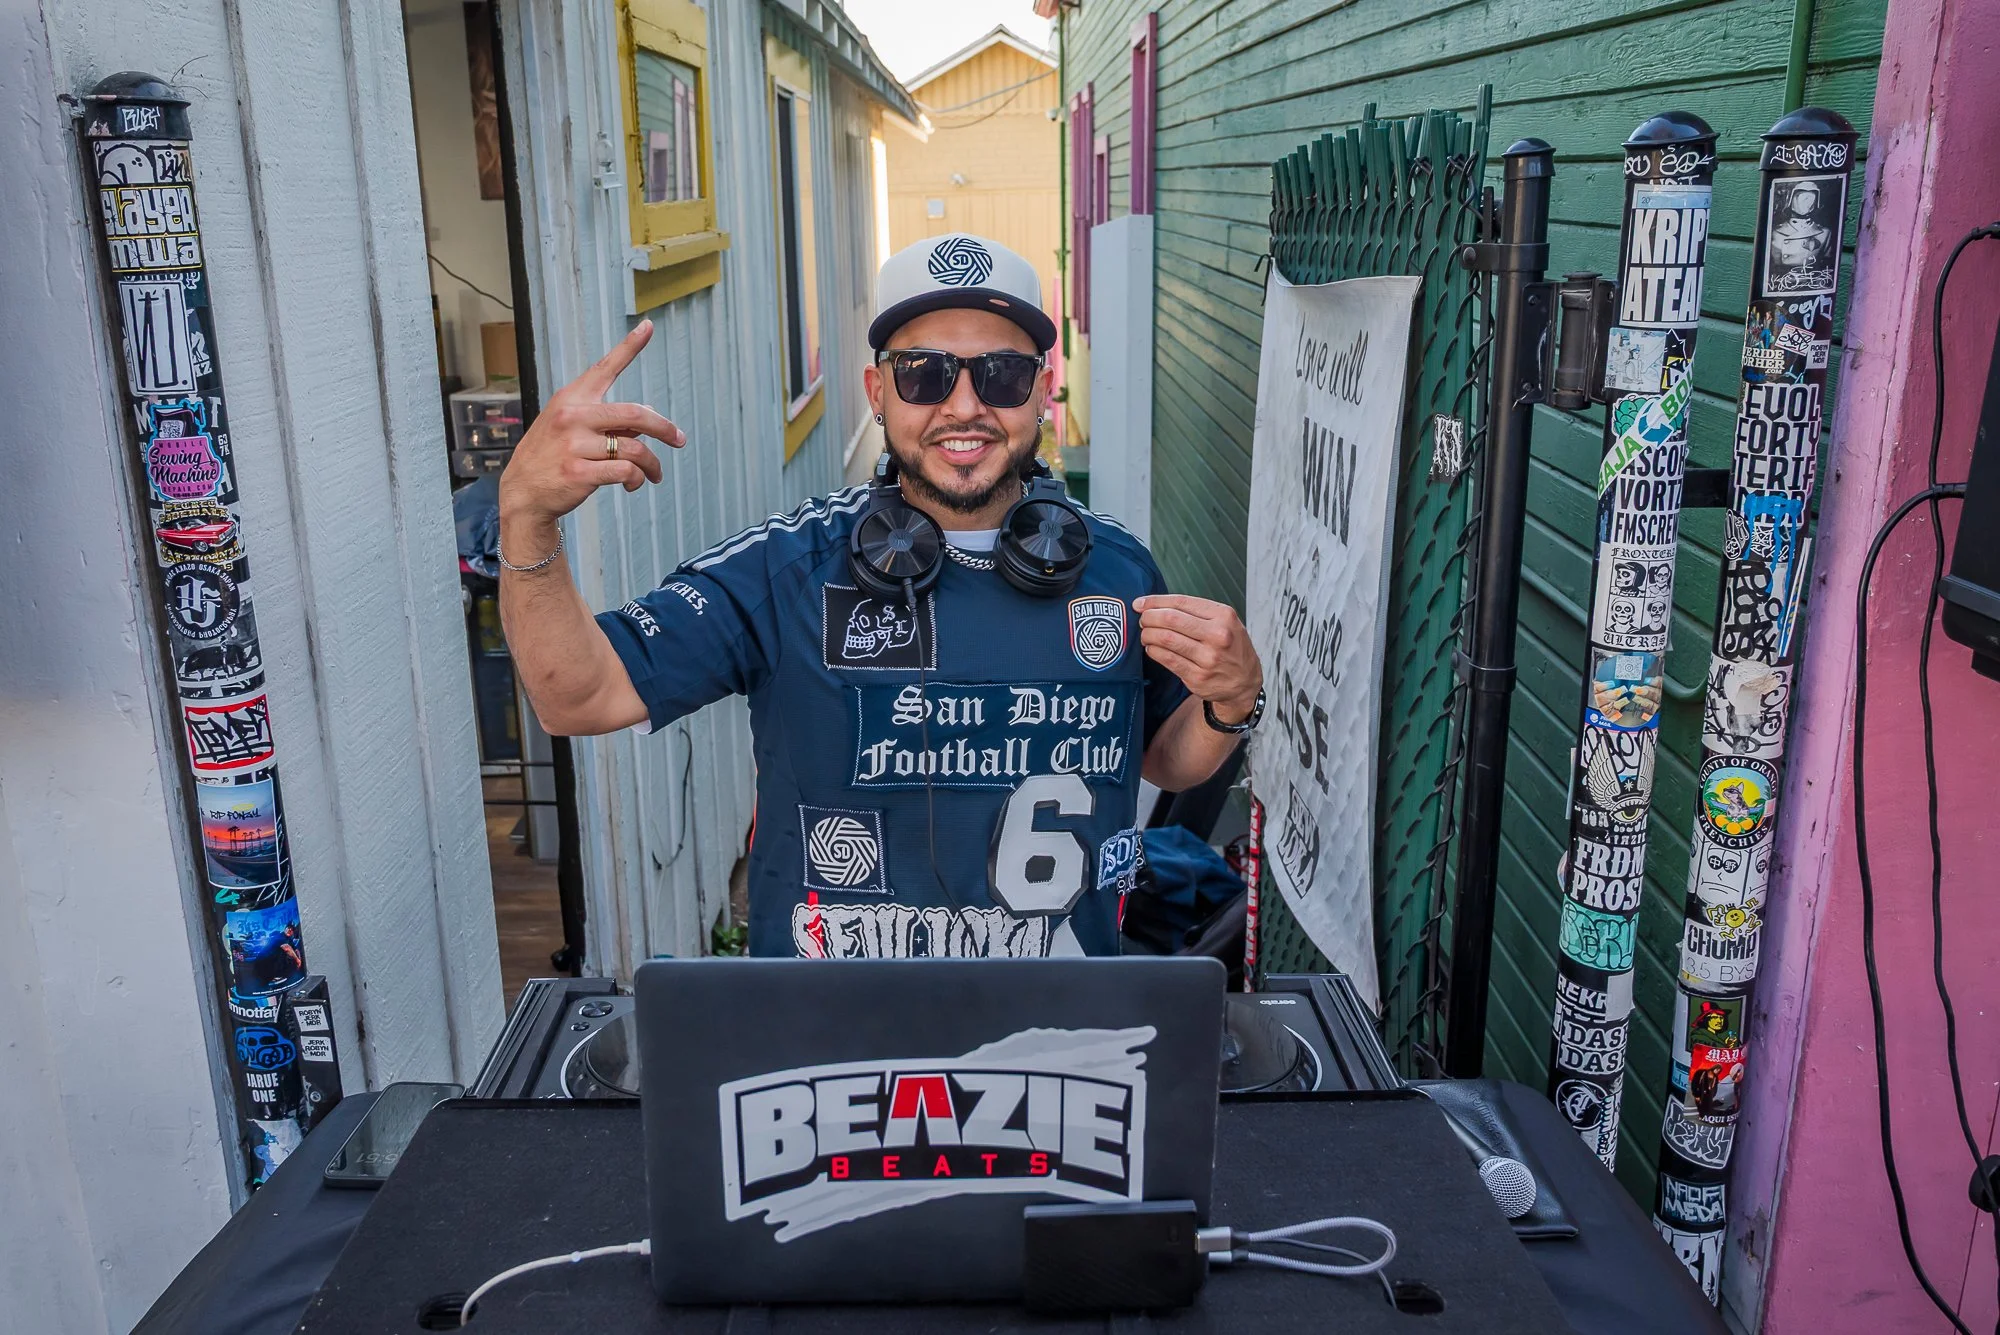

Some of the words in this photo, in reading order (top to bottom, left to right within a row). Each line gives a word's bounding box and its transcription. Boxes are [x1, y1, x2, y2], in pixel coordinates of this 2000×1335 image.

[953, 255, 969, 265] SD
[1296, 312, 1328, 390] Love
[1329, 328, 1369, 406] will
[1737, 417, 1820, 456] FORTY
[150, 447, 202, 470] Sewing
[1598, 436, 1643, 490] BAJA
[151, 465, 217, 486] Machine
[1303, 417, 1357, 547] WIN
[199, 564, 220, 575] OSAKA
[1075, 604, 1092, 618] SAN
[1094, 603, 1119, 618] DIEGO
[1094, 636, 1104, 645] FC
[1604, 632, 1666, 648] ULTRAS
[892, 685, 985, 727] San
[1008, 684, 1116, 730] Diego
[858, 738, 1031, 780] Football
[1050, 736, 1125, 775] Club
[1731, 758, 1748, 767] OF
[1699, 814, 1768, 847] FRENCHIES
[990, 774, 1096, 914] 6
[252, 1089, 277, 1103] ONE
[739, 1072, 1129, 1186] BEAZIE
[1702, 1115, 1725, 1123] AQUI
[831, 1153, 1048, 1178] BEATS
